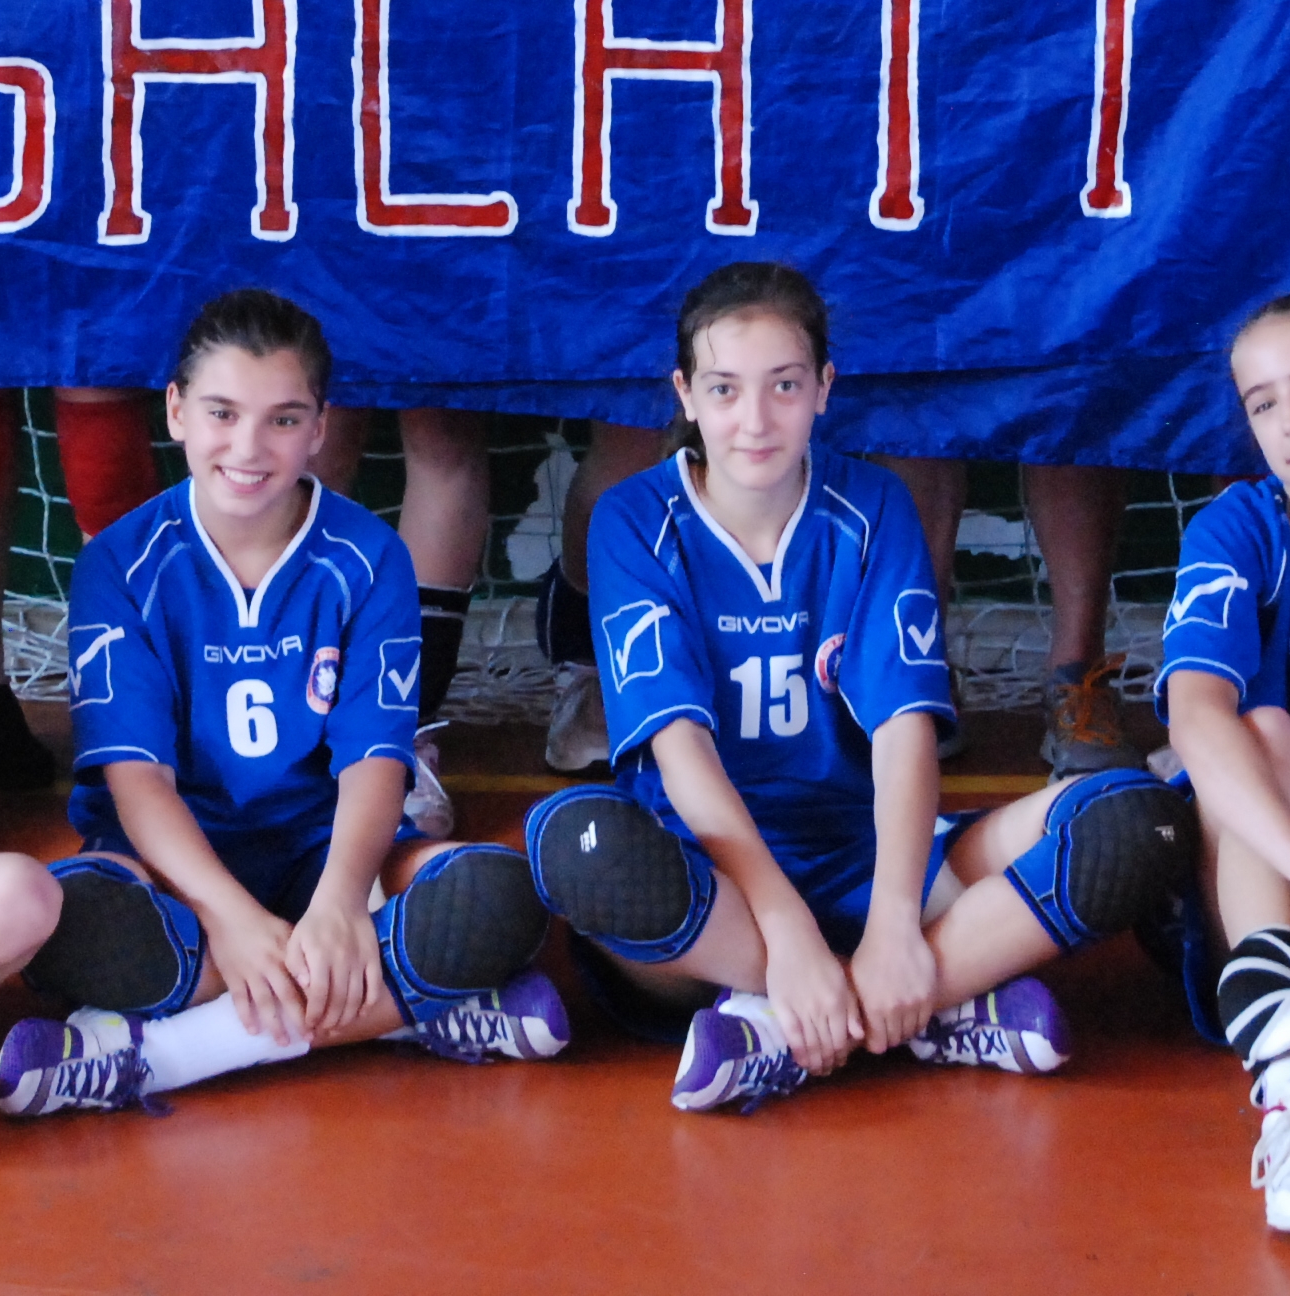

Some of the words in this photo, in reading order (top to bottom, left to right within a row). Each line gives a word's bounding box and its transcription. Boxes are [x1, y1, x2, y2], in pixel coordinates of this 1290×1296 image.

[203, 634, 304, 665] GIVOVA
[718, 613, 809, 634] GIVOVA
[225, 678, 279, 758] 6
[729, 654, 810, 740] 15
